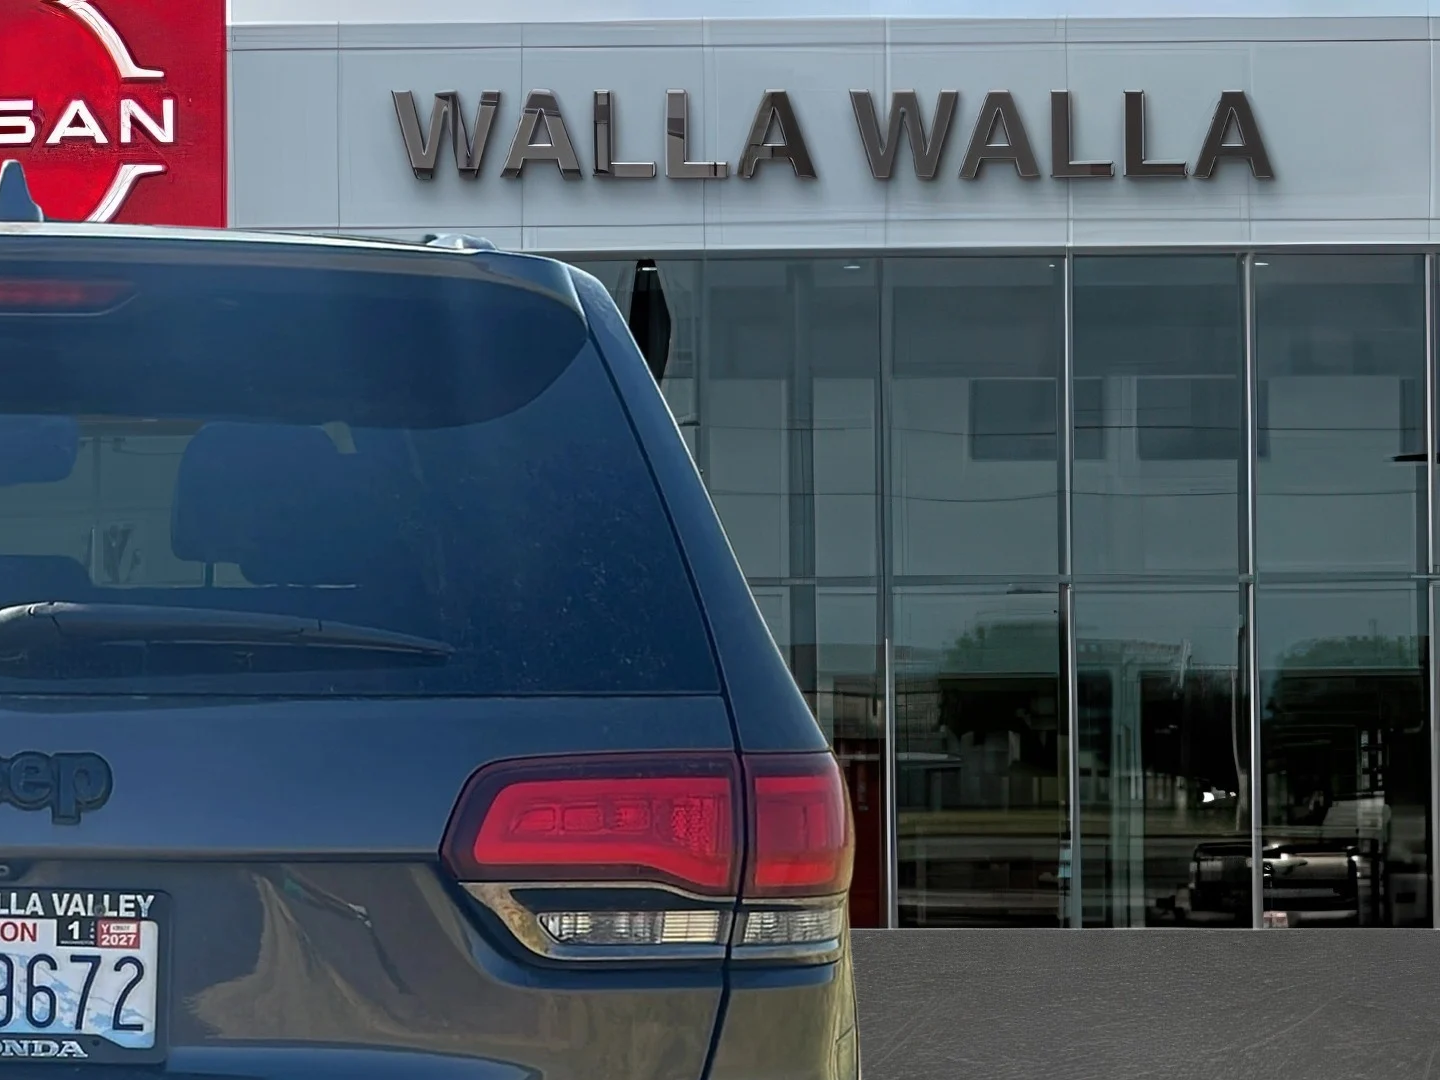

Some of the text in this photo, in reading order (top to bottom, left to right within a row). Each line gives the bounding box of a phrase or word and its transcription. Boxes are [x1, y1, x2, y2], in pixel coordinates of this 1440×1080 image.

[391, 88, 1276, 180] WALLA WALLA
[52, 893, 155, 918] VALLEY
[67, 920, 80, 940] 1
[101, 934, 137, 946] 2027
